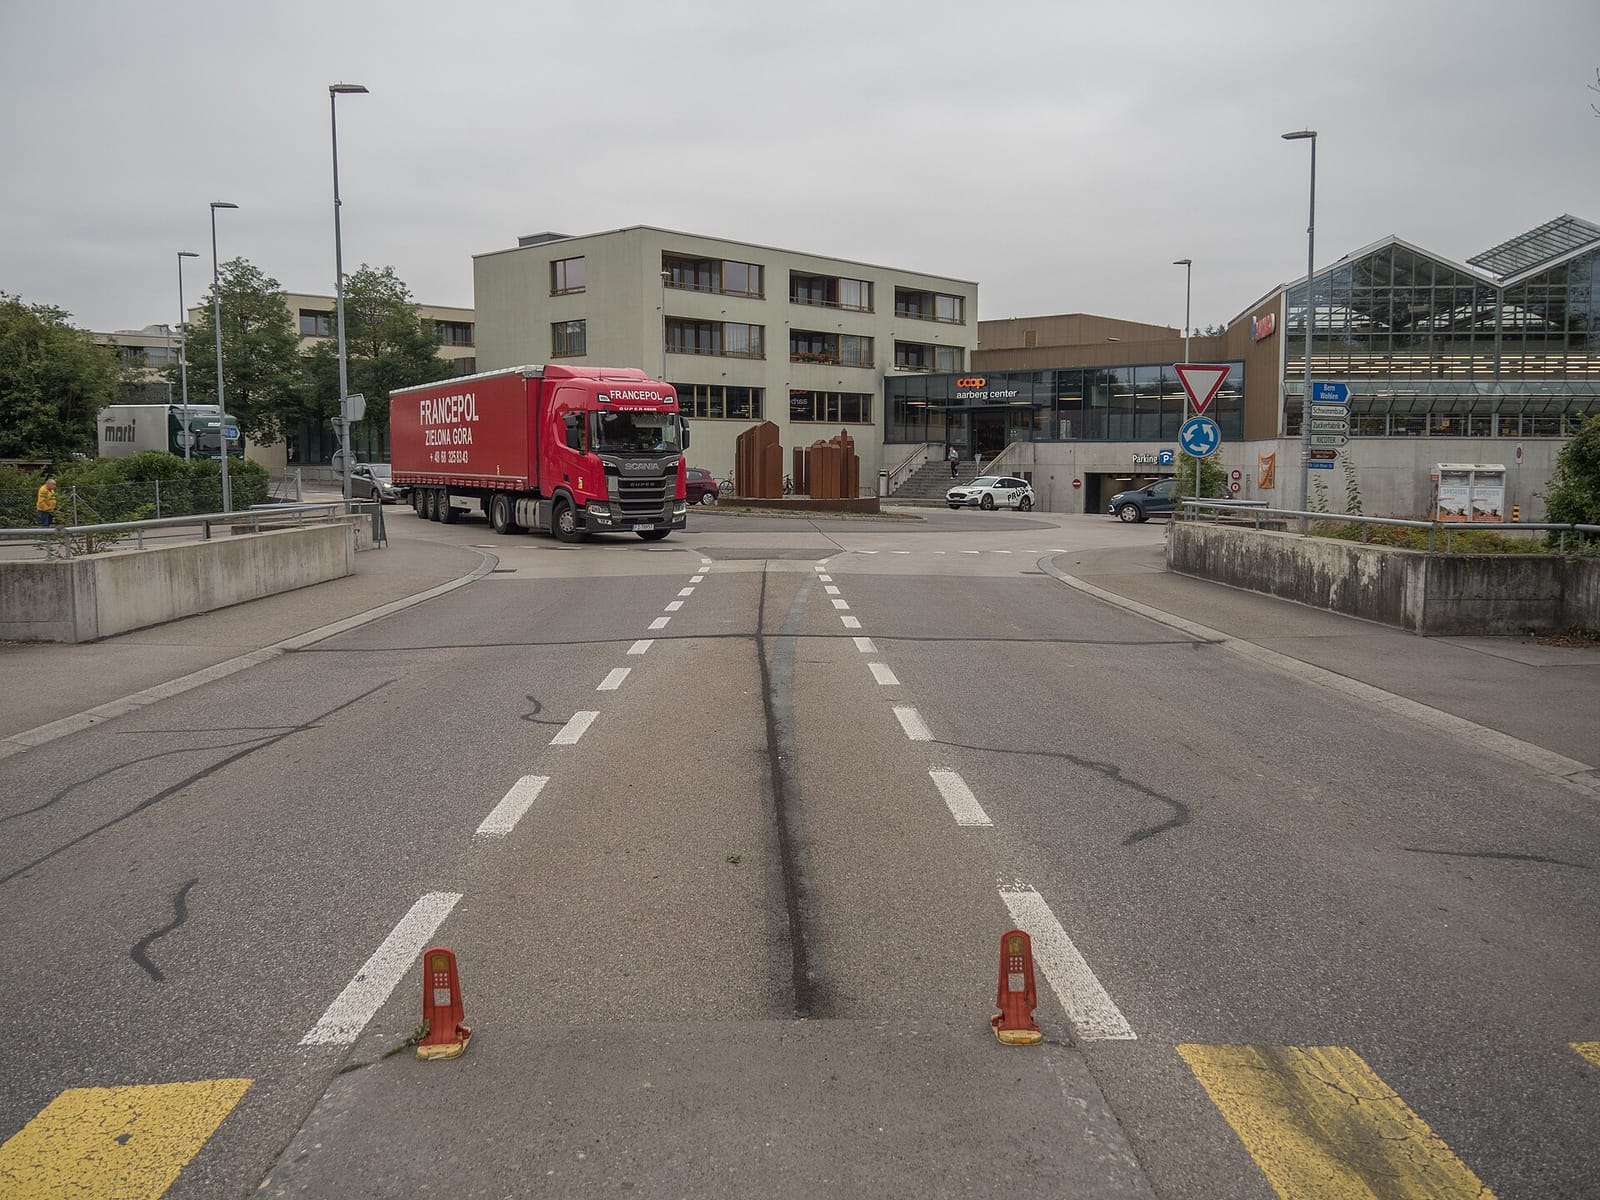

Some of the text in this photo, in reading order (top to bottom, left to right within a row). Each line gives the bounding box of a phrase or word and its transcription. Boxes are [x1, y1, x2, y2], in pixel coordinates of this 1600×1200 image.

[957, 378, 986, 389] coop
[1323, 383, 1336, 392] Bern
[609, 389, 663, 401] FRANCEPOL
[956, 390, 1017, 400] aarberg center
[1319, 392, 1339, 400] Wohlen
[419, 393, 479, 426] FRANCEPOL
[1312, 406, 1345, 416] Schwimmbad
[104, 418, 136, 442] marti
[425, 424, 473, 446] ZIELONA GÓRA
[1132, 454, 1158, 465] Parking
[624, 462, 660, 470] SCANIA
